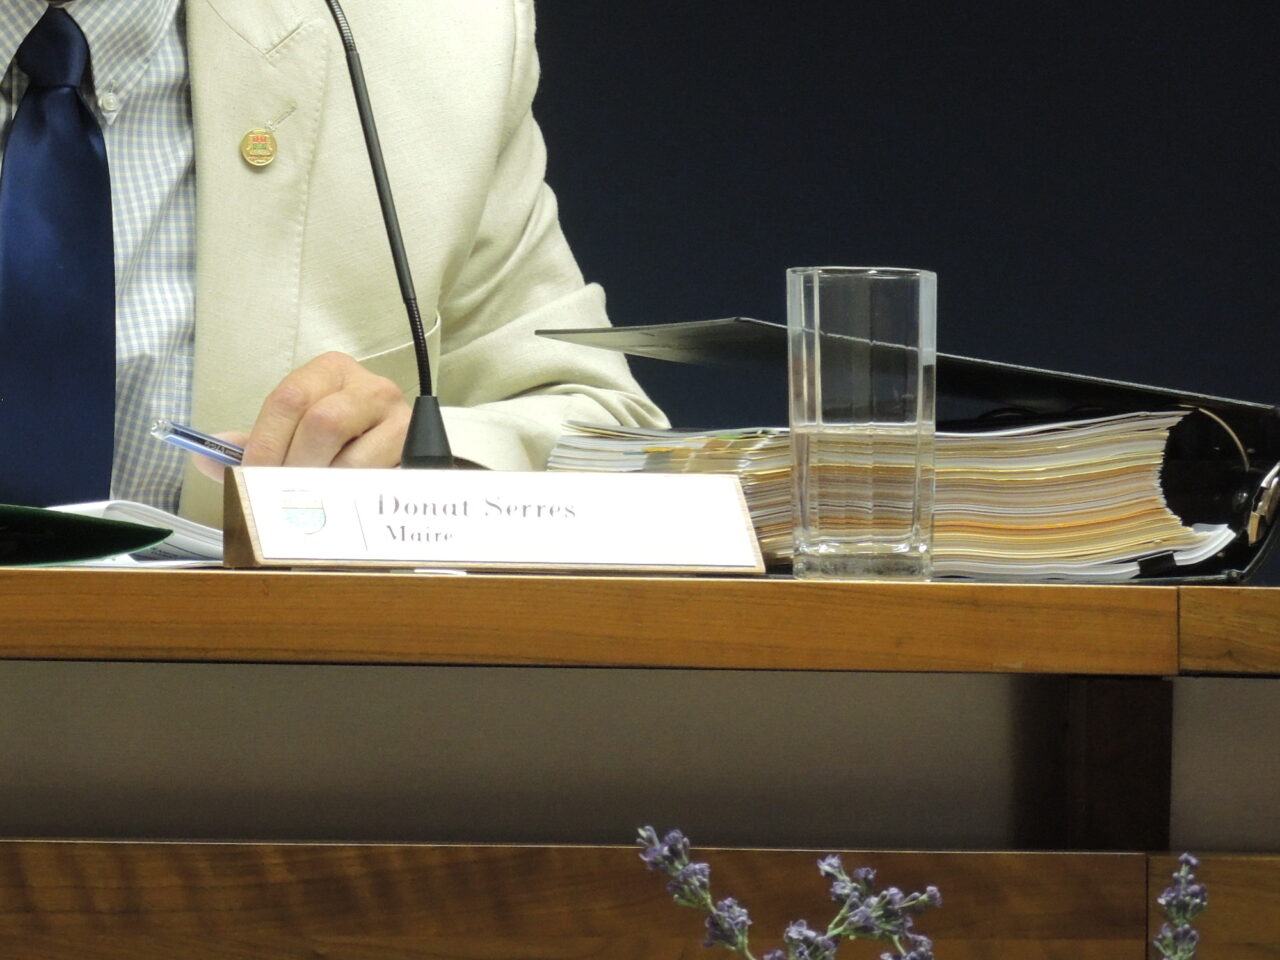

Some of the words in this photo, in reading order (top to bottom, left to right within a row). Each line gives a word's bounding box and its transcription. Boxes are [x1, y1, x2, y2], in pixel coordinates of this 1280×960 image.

[377, 493, 469, 517] Donat
[484, 496, 577, 518] Serres
[385, 525, 453, 542] Maire
